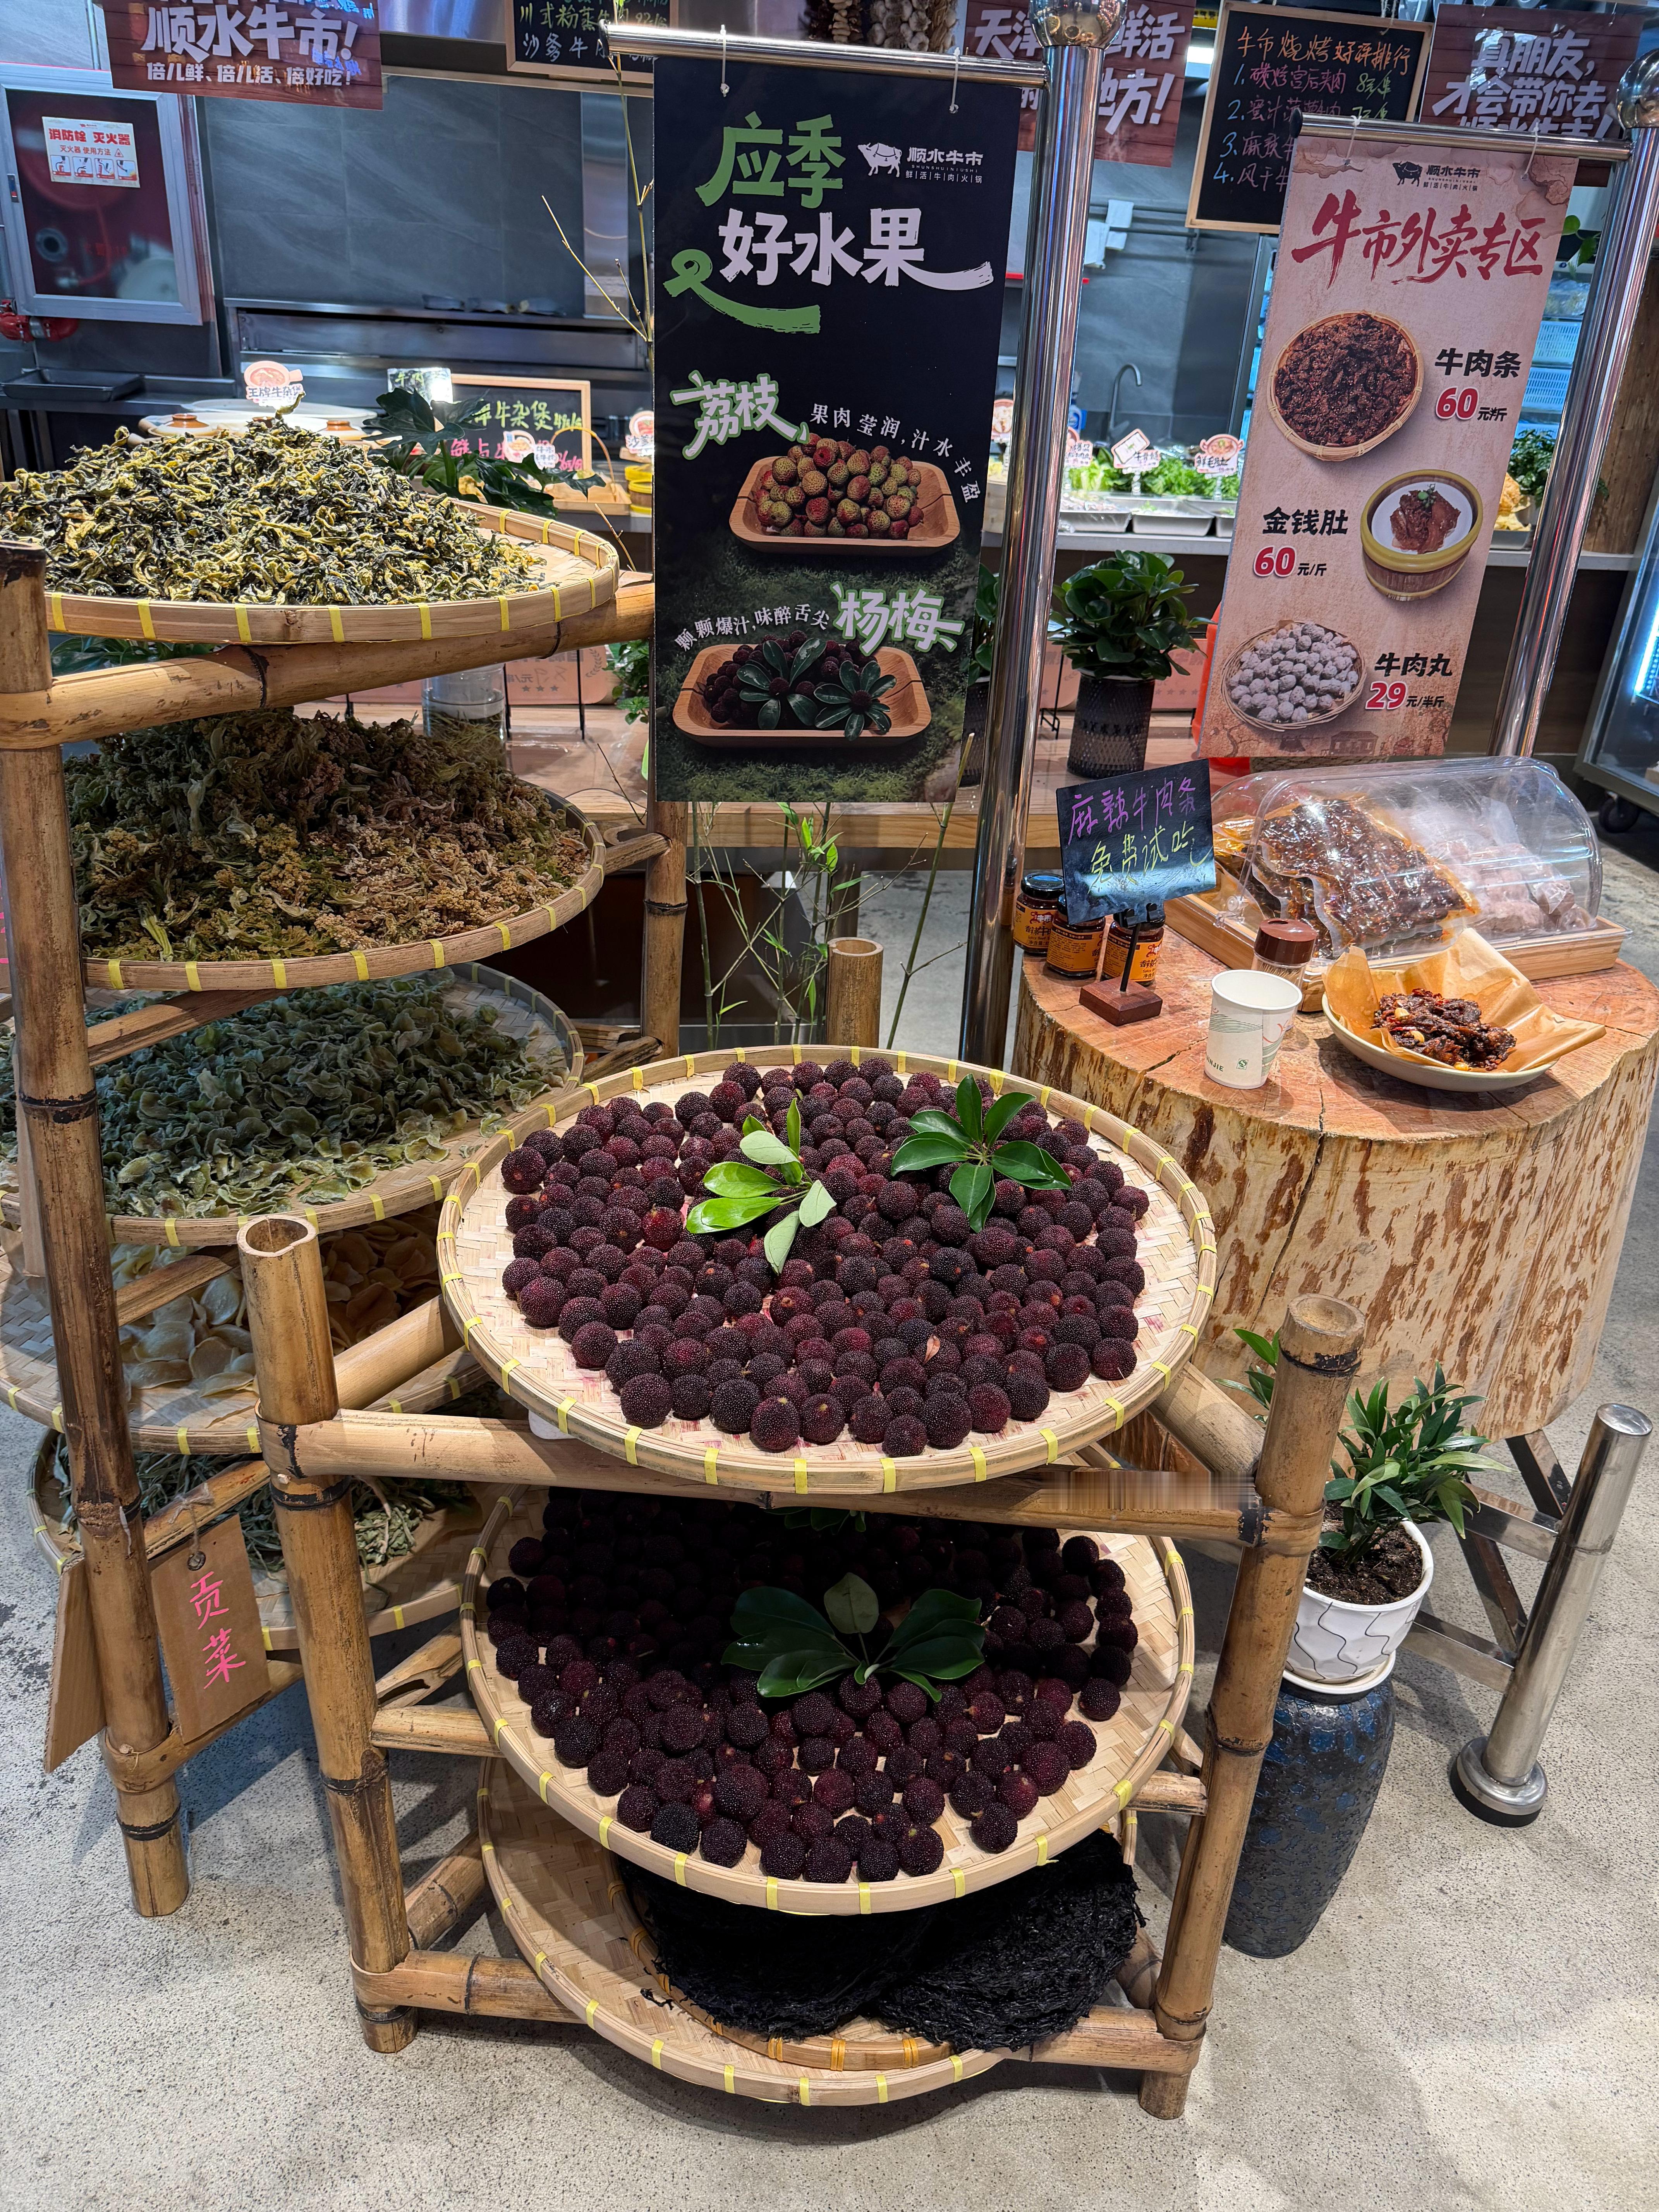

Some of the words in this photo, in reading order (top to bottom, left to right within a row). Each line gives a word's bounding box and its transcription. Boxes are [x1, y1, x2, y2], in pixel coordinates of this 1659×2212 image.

[140, 4, 359, 63] 顺水牛市!
[975, 4, 1186, 60] 天津鲜活
[1432, 75, 1607, 120] 才会带你去
[48, 128, 87, 143] 消防栓
[93, 131, 131, 146] 灭火器
[60, 145, 81, 154] 灭火器
[1220, 131, 1237, 158] 3.
[695, 111, 846, 208] 应季
[907, 147, 984, 166] 顺水牛市
[1213, 162, 1234, 185] 4.
[1426, 164, 1481, 179] 顺水牛市
[718, 208, 994, 290] 好水果
[1291, 189, 1546, 290] 牛市外卖专区
[1434, 348, 1522, 379] 牛肉条
[669, 370, 810, 460] 荔枝
[1262, 506, 1348, 536] 金钱肚
[830, 581, 965, 657] 杨梅
[1374, 652, 1453, 677] 牛肉丸
[189, 1571, 246, 1690] 贡菜
